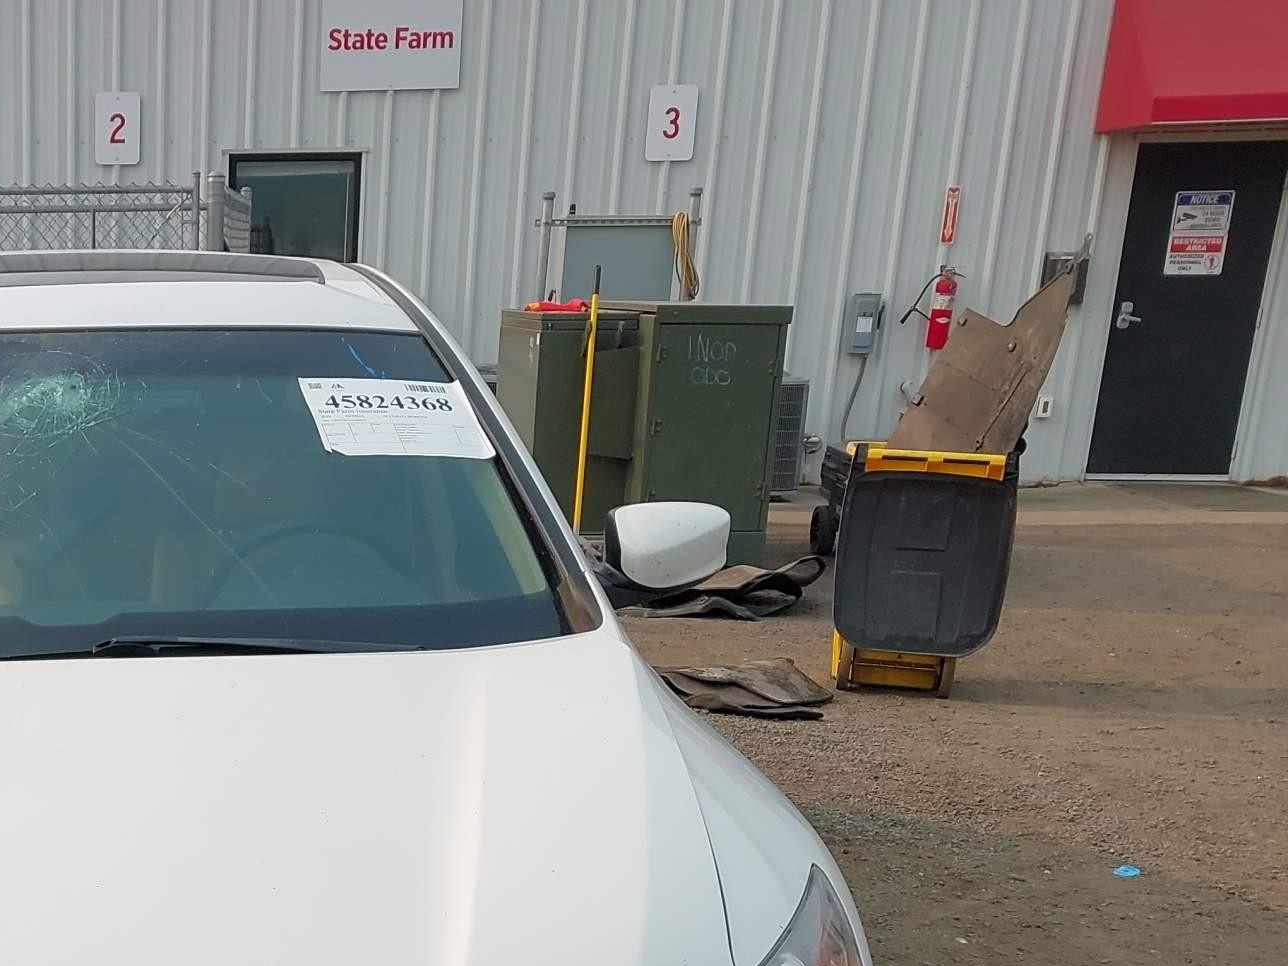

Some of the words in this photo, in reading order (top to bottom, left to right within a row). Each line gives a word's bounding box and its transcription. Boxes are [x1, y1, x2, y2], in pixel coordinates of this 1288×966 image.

[327, 27, 389, 51] State
[394, 26, 455, 50] Farm
[109, 112, 126, 144] 2
[662, 106, 681, 139] 3
[1190, 194, 1220, 204] NOTICE
[324, 394, 454, 412] 45824368
